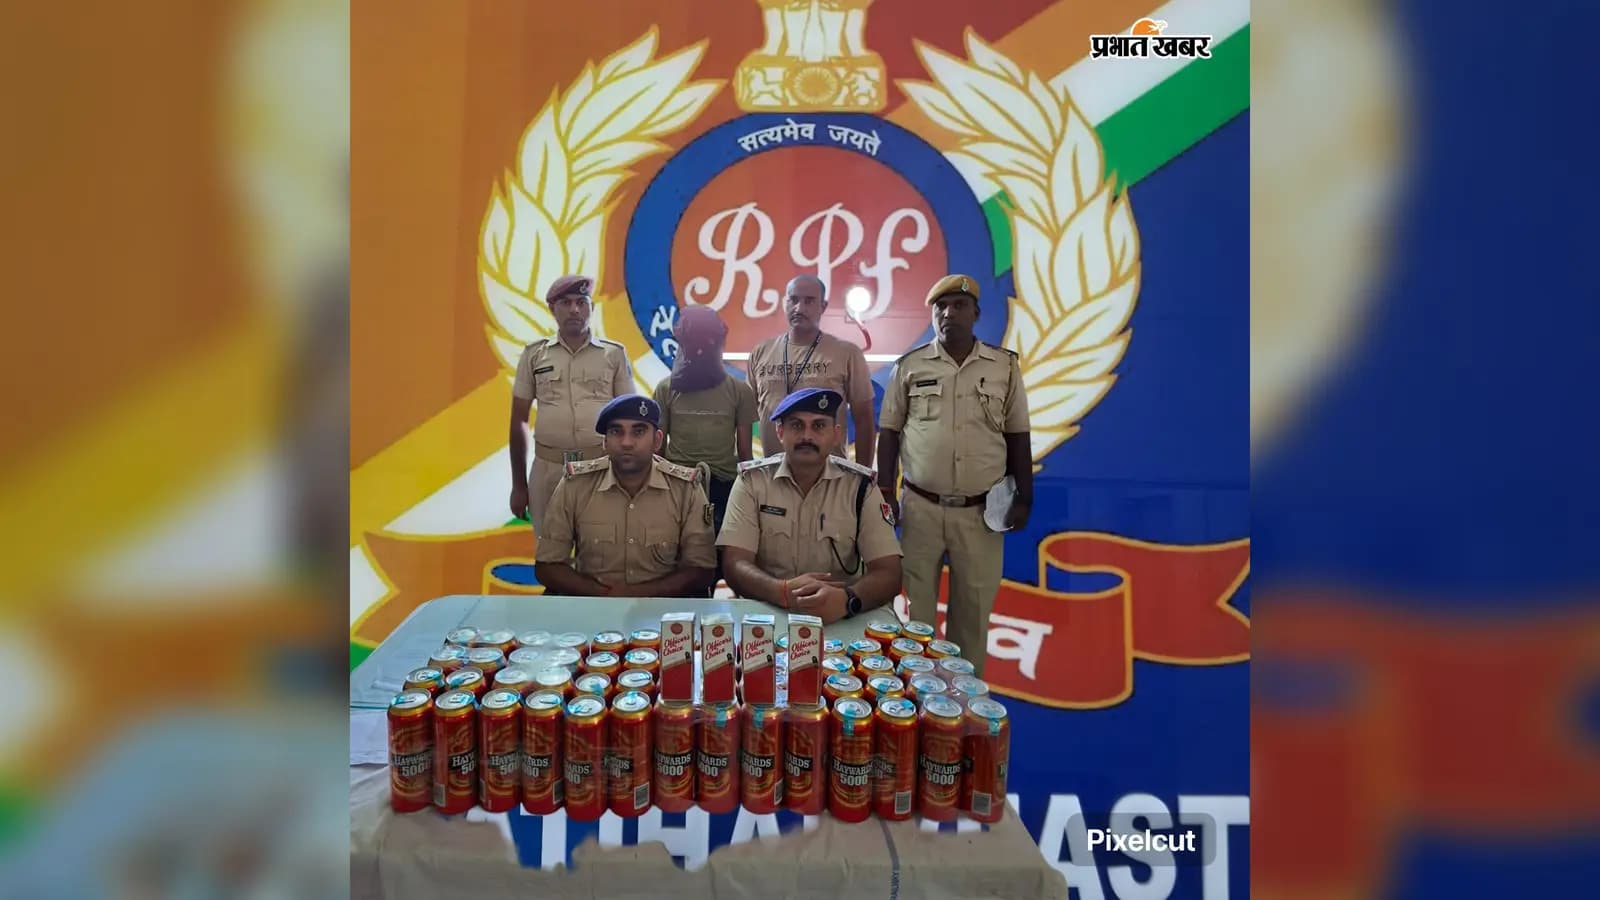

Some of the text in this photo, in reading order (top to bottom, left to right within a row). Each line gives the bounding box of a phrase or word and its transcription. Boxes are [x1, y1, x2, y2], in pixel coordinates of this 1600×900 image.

[737, 117, 882, 156] सत्यमेव जयते
[840, 774, 868, 787] 5000
